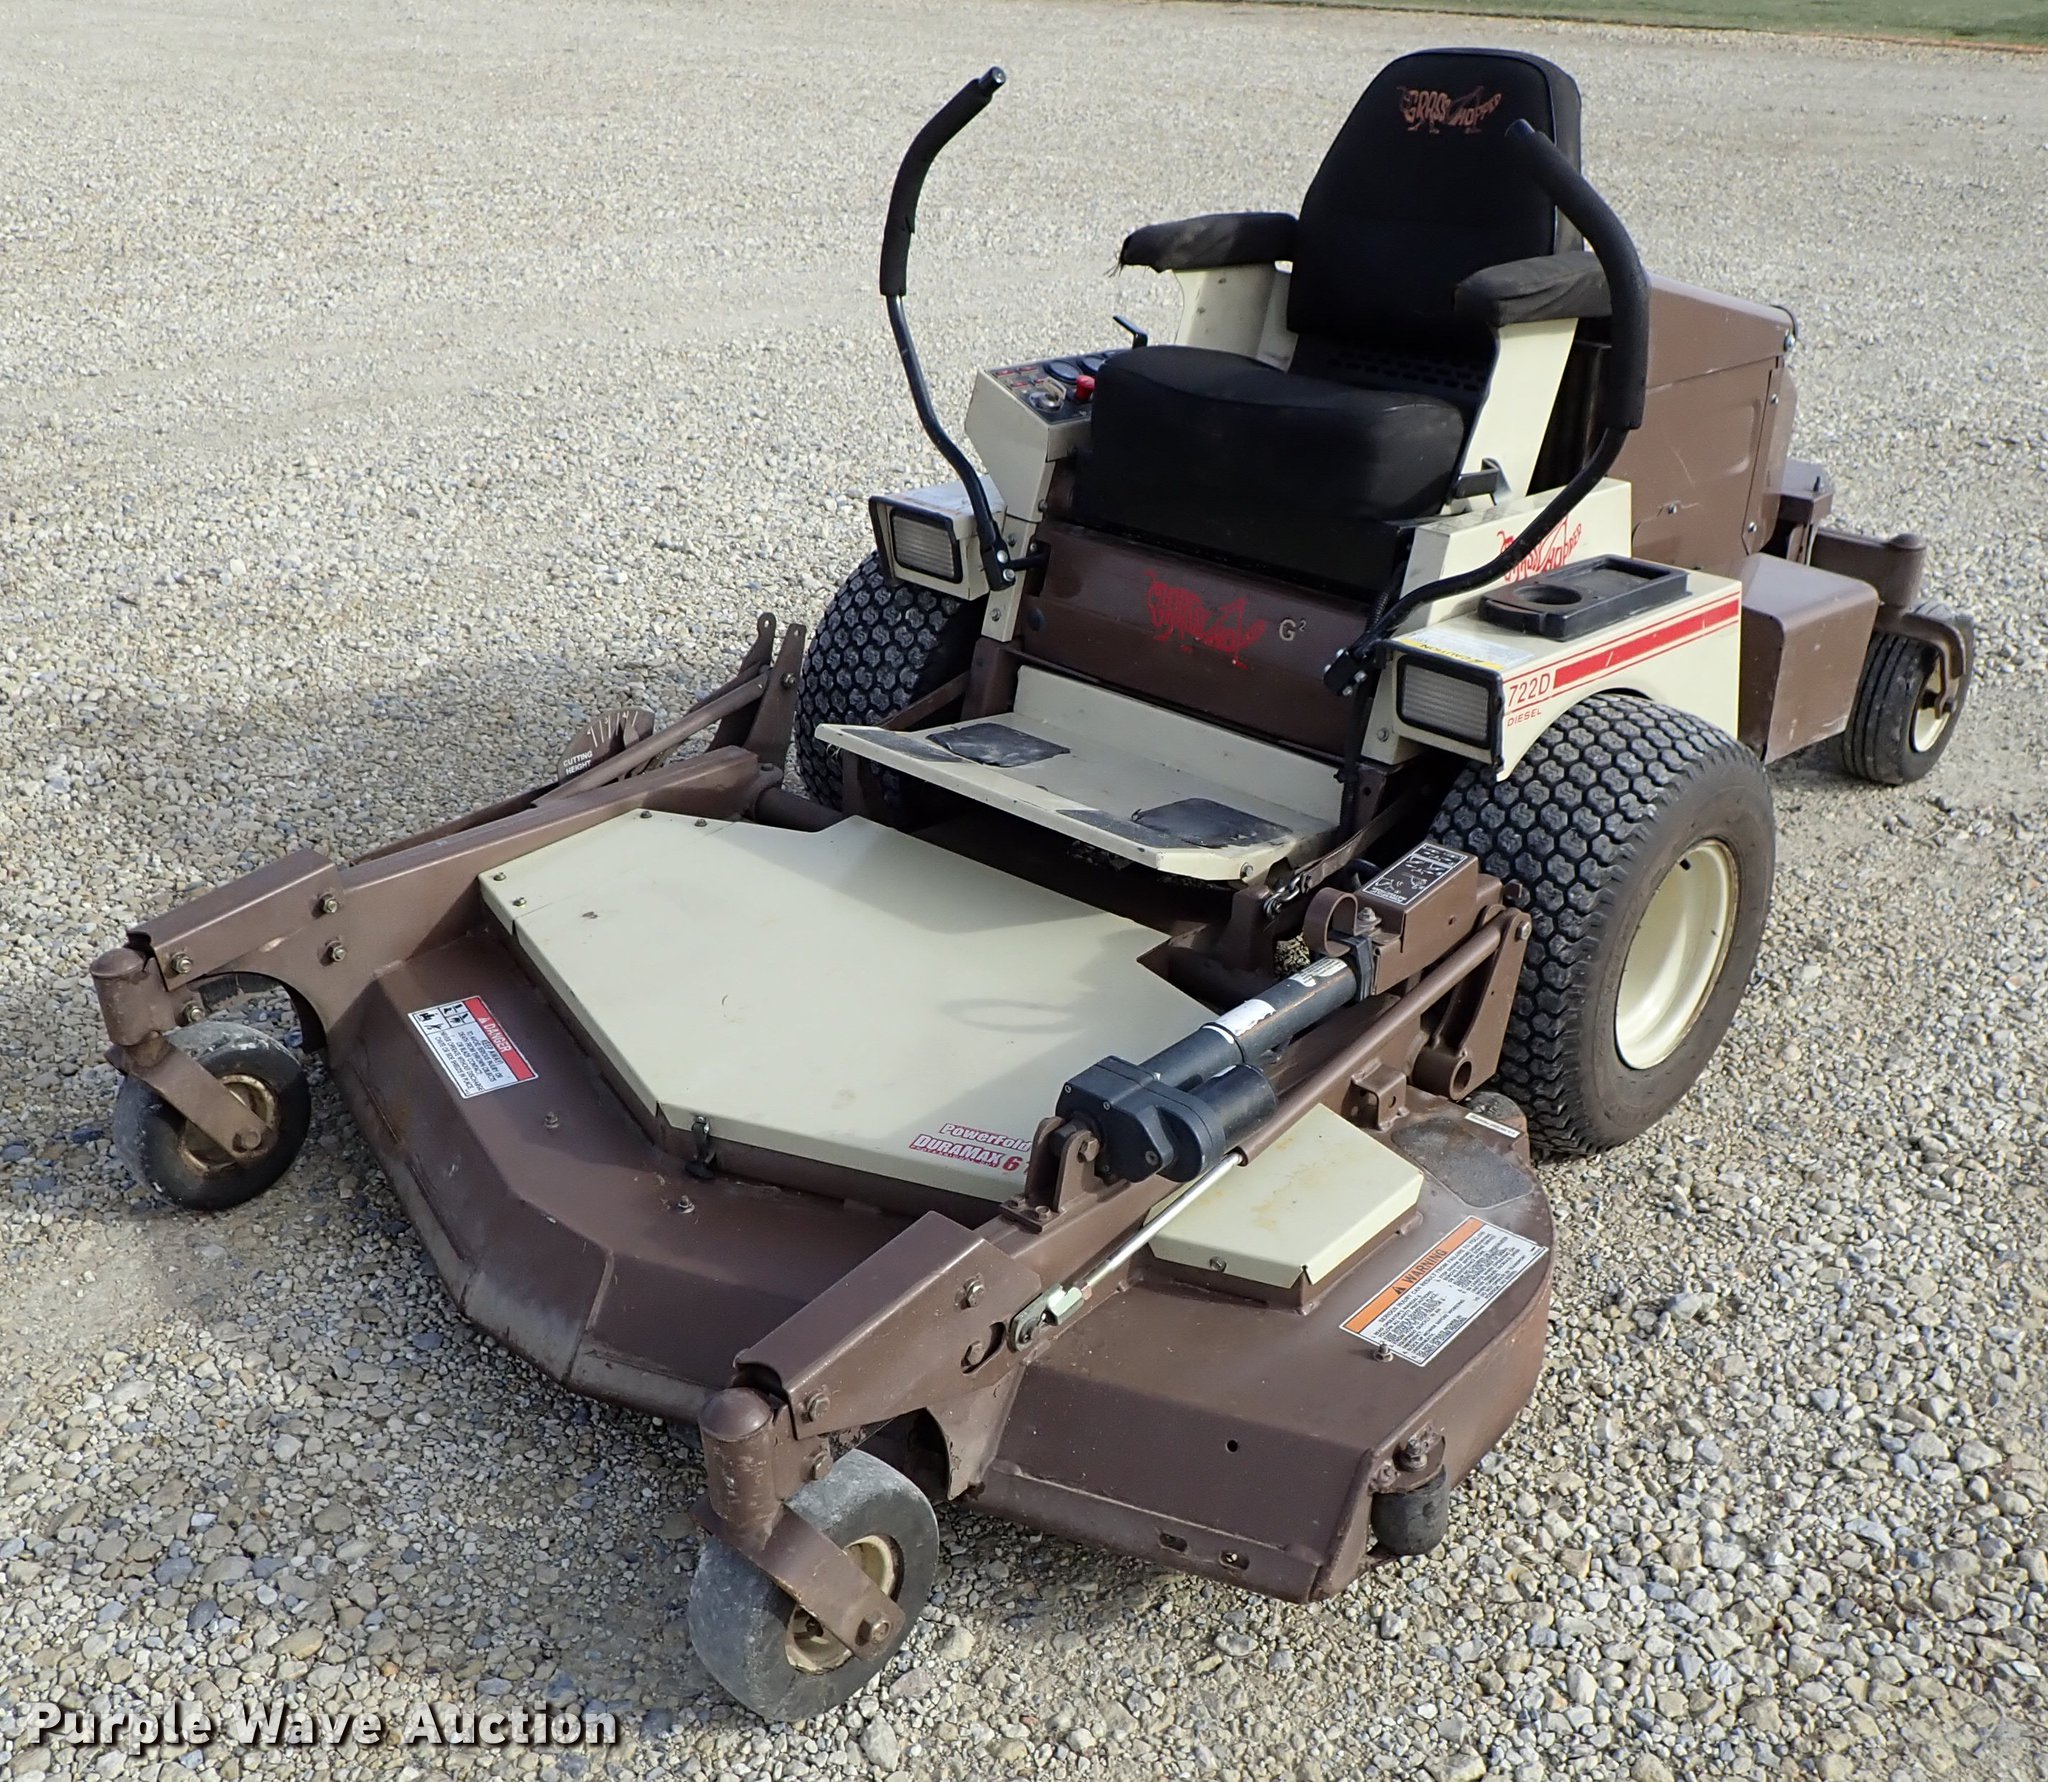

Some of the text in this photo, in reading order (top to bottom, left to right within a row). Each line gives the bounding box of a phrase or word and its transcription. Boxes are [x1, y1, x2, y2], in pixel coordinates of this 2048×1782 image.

[1508, 672, 1551, 708] 722D
[1507, 708, 1542, 728] DIESEL
[563, 750, 593, 768] CUTTING
[565, 759, 592, 776] HEIGHT
[482, 1022, 513, 1053] DANGER
[1401, 1247, 1448, 1284] WARNING
